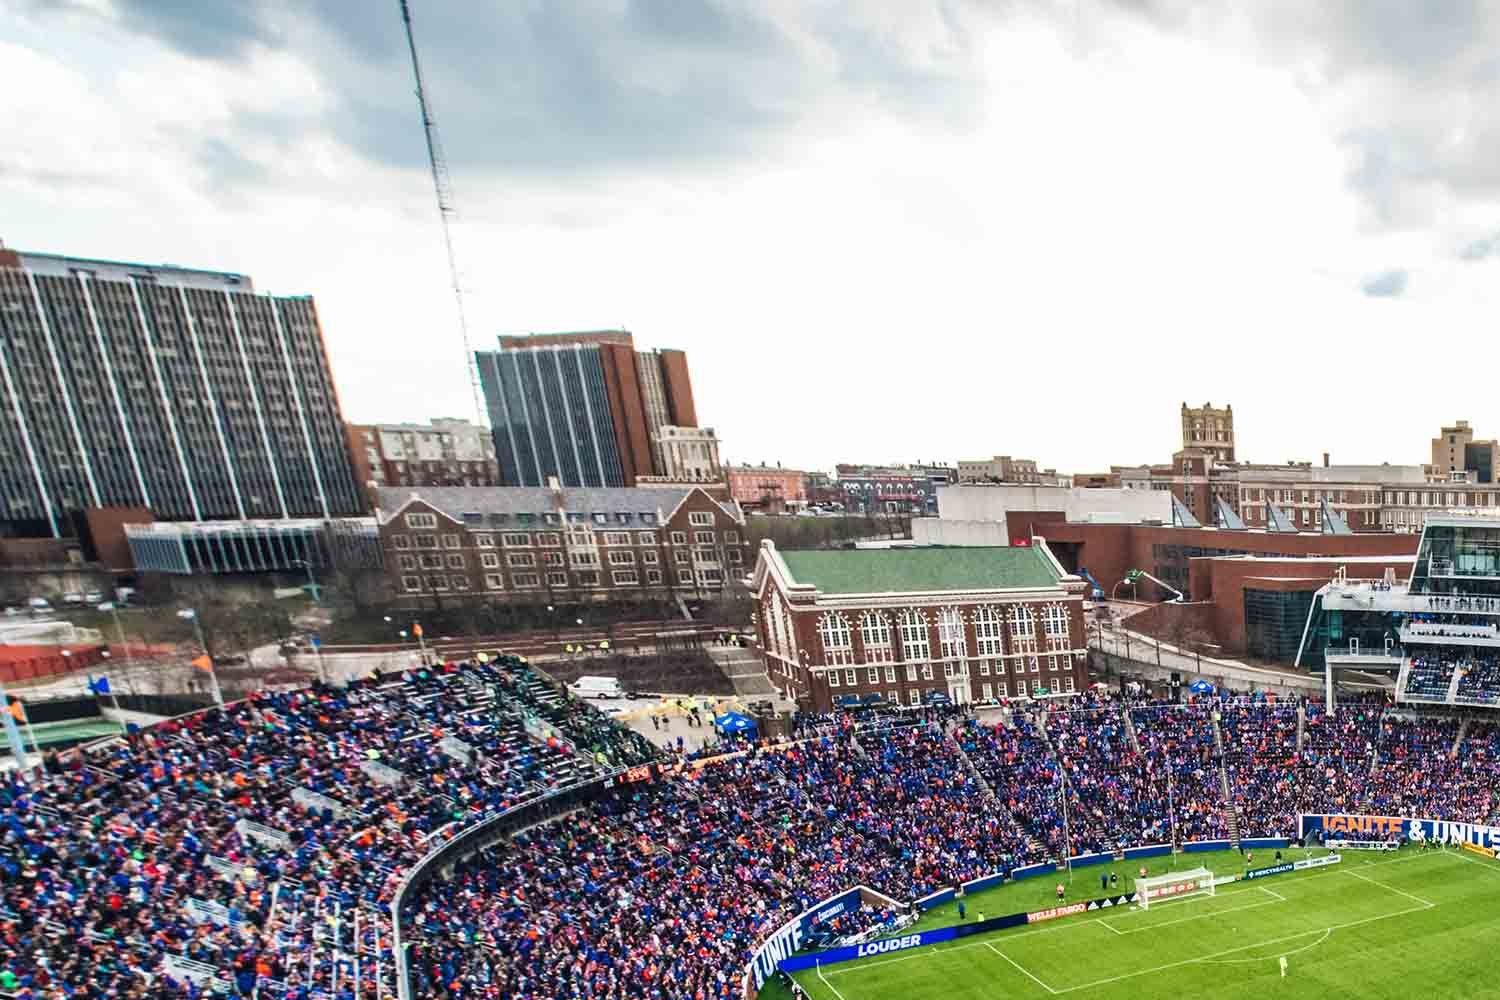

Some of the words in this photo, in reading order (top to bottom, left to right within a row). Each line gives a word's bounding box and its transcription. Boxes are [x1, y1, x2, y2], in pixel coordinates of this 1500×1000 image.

[1323, 816, 1403, 832] IGNITE
[1408, 820, 1426, 841] &
[1027, 909, 1057, 921] WELLS
[1057, 903, 1086, 916] FARGO
[762, 920, 804, 977] UNITE
[858, 934, 921, 957] LOUDER
